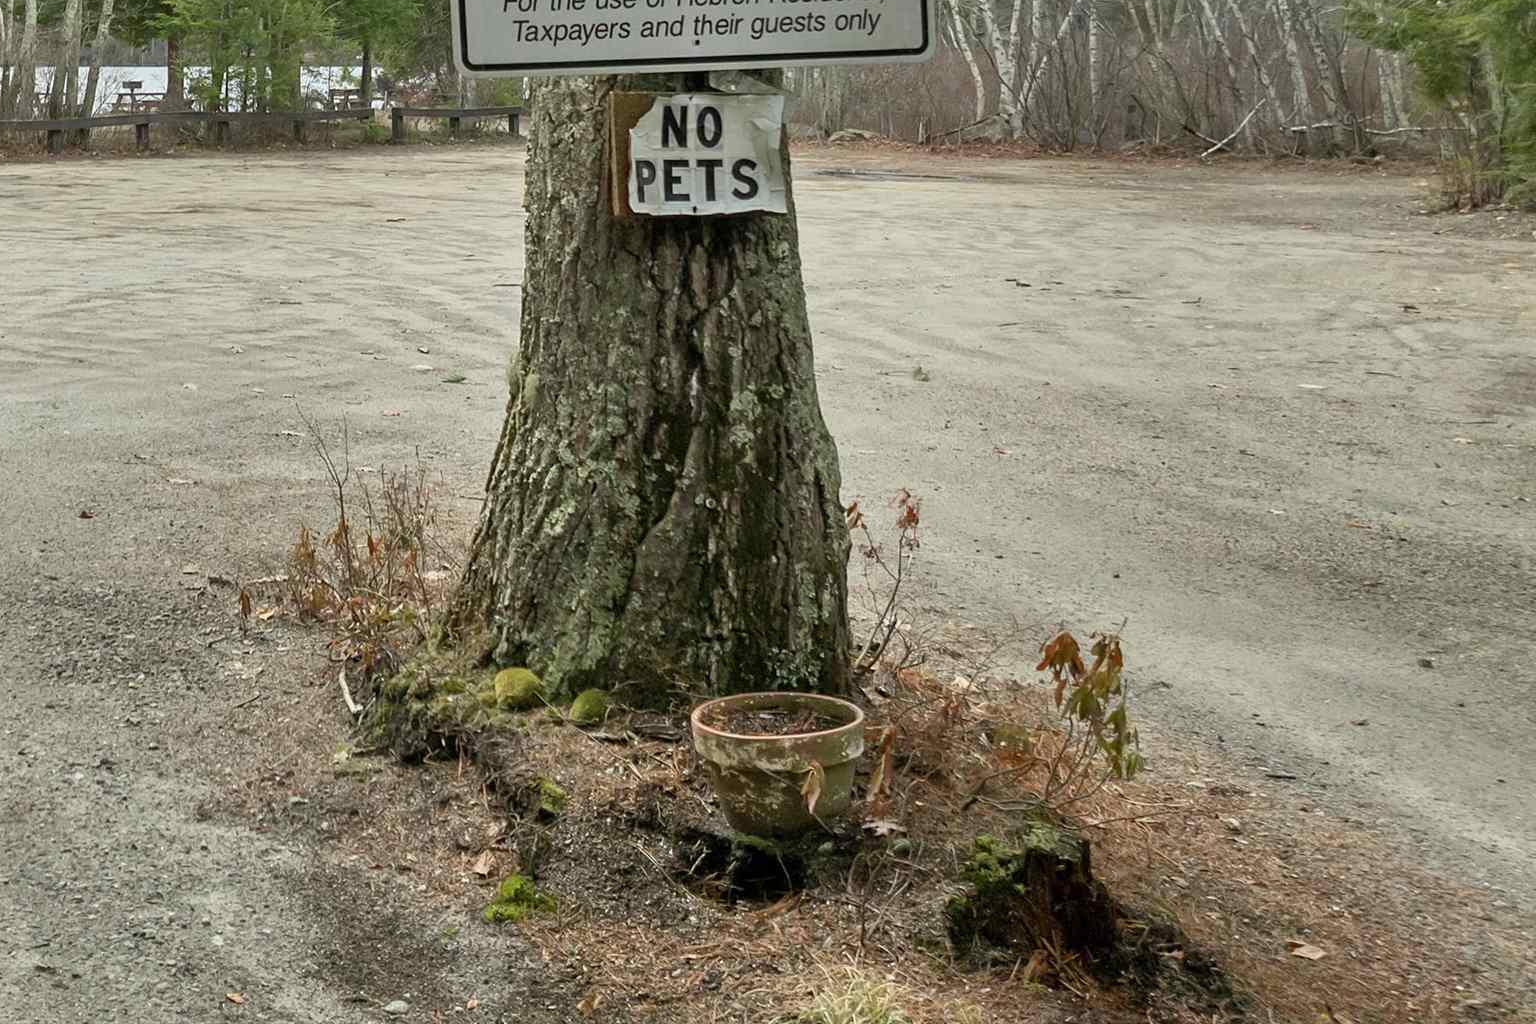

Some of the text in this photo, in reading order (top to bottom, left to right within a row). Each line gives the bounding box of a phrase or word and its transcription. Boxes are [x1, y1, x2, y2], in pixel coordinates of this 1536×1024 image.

[512, 8, 882, 47] Taxpayers and their guests only
[661, 105, 723, 148] NO
[635, 158, 759, 203] PETS
